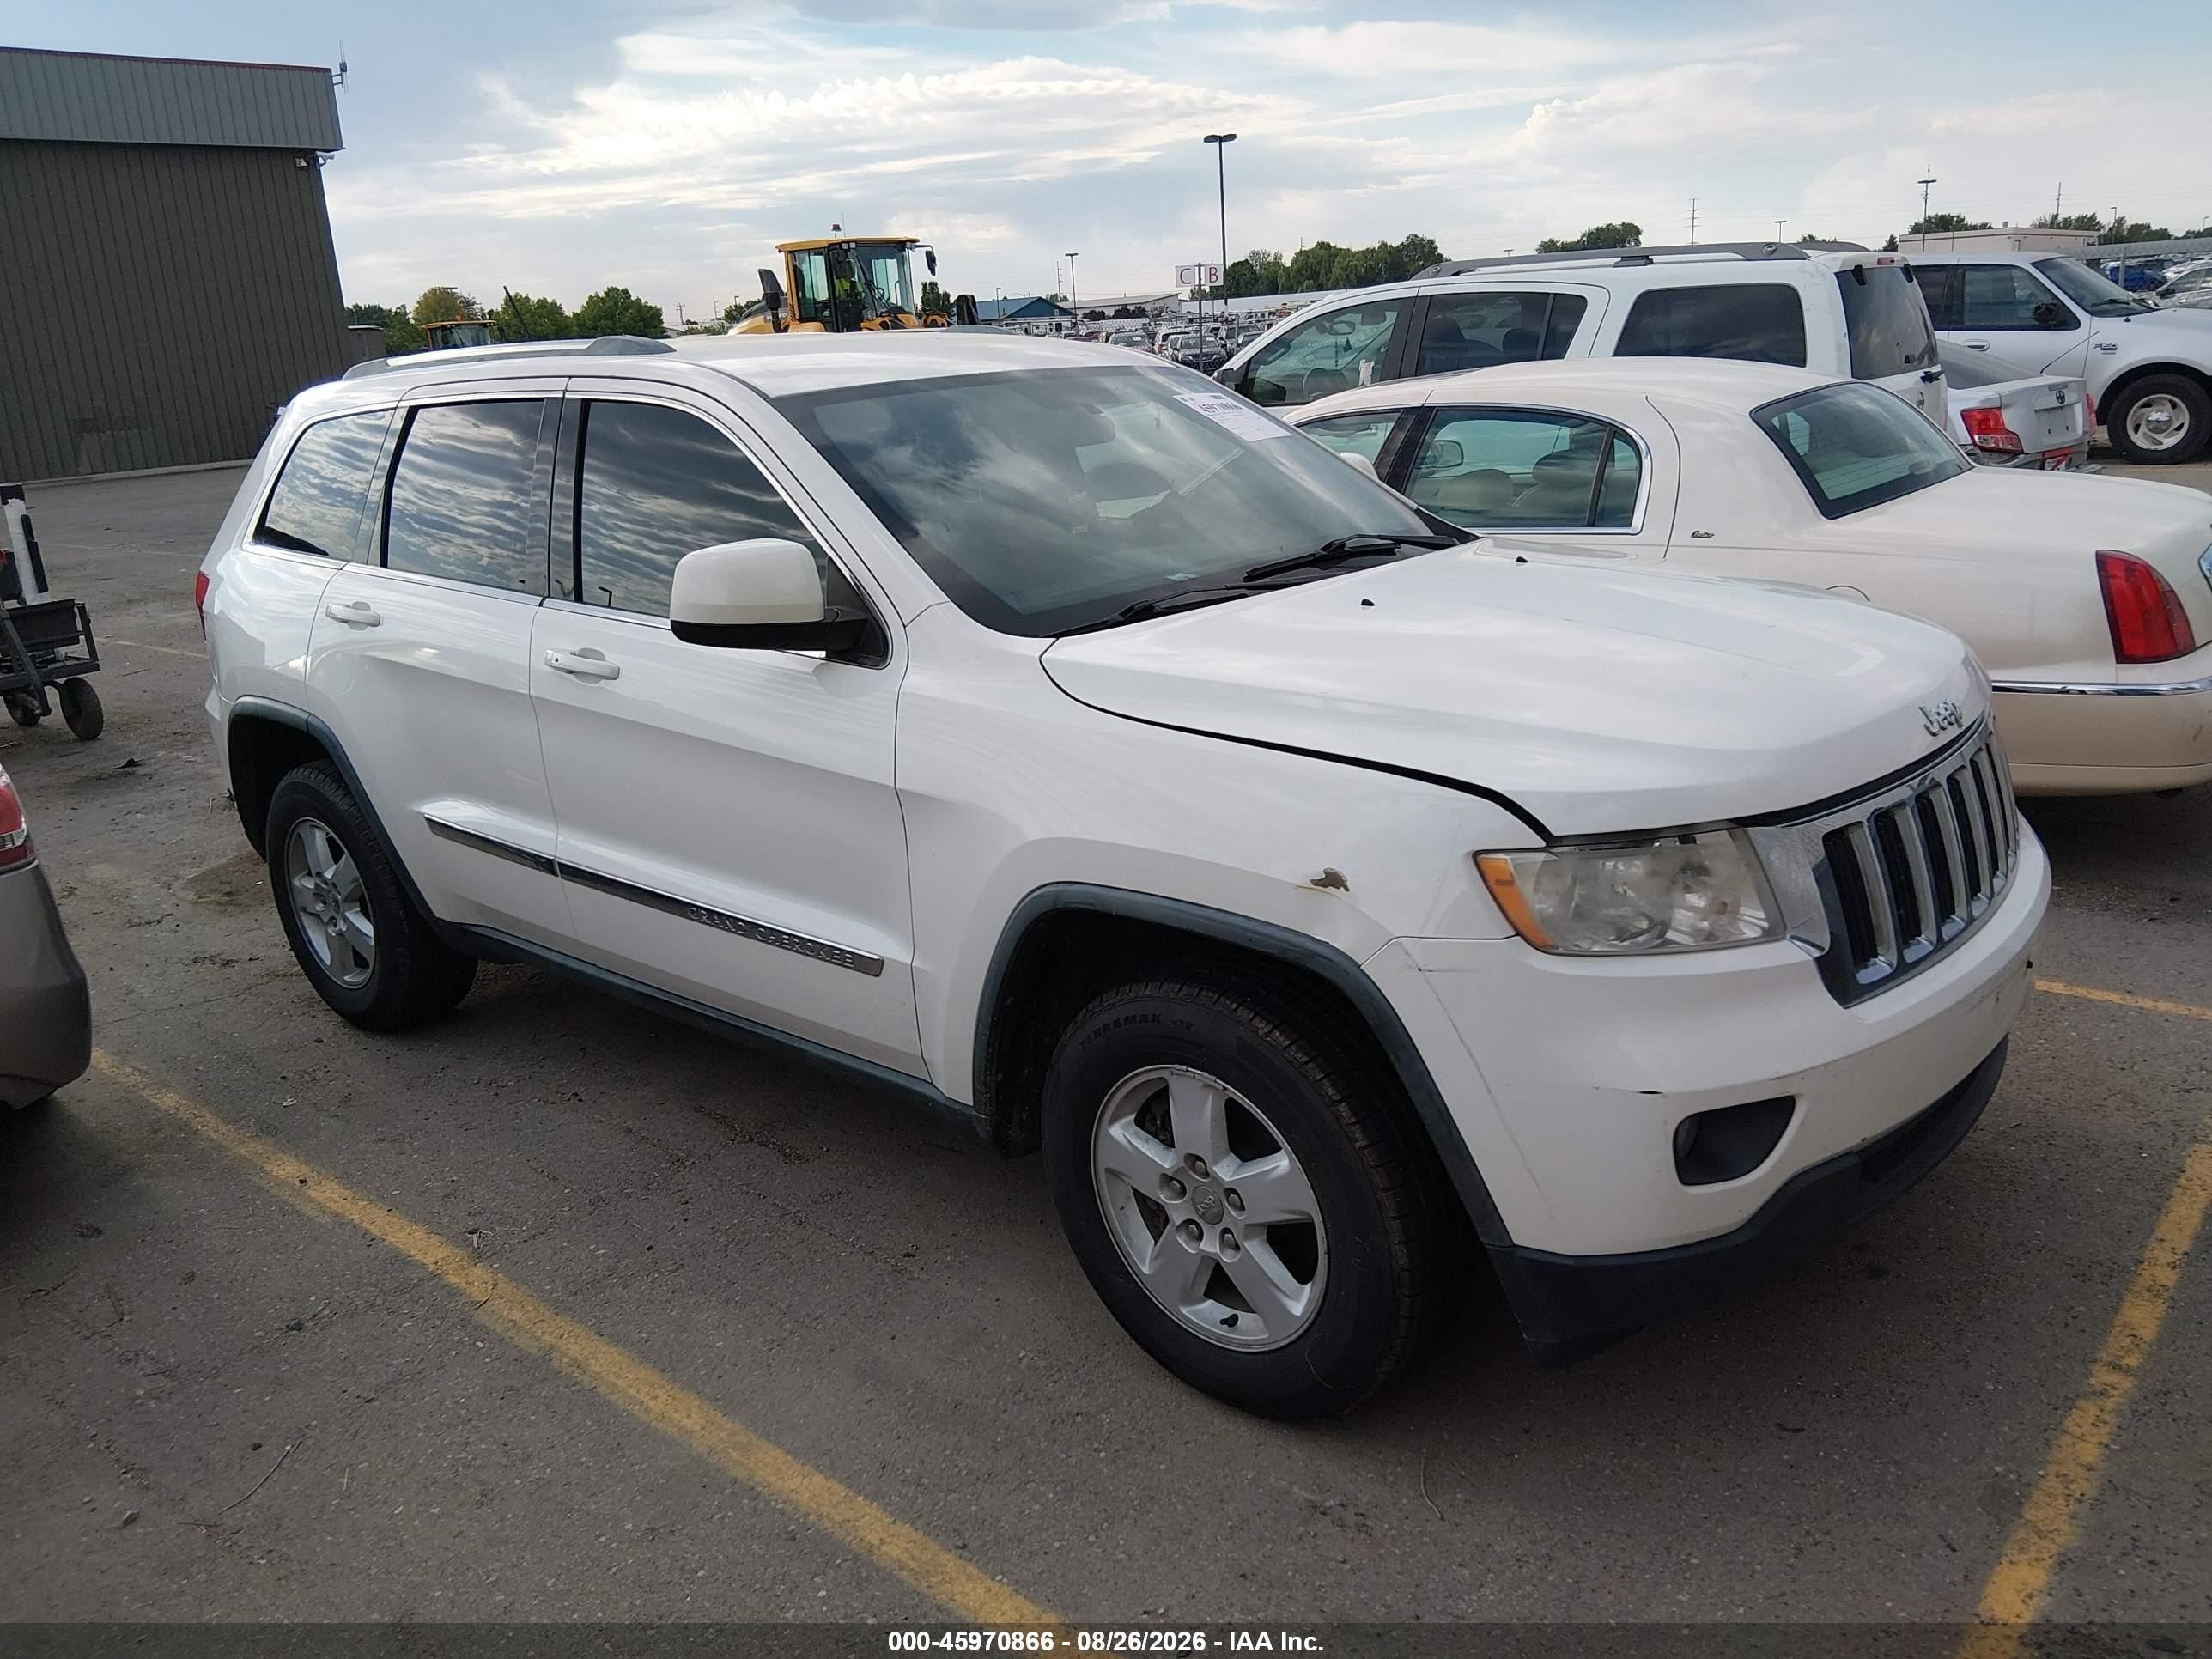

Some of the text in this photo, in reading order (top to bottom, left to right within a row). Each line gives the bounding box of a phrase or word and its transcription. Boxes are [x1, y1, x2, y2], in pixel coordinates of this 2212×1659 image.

[1179, 267, 1192, 285] C
[1208, 266, 1218, 283] B
[1917, 698, 1964, 737] Jeep
[687, 907, 855, 968] GRAND CHEROKEE
[1078, 1012, 1163, 1050] TERRAMAX
